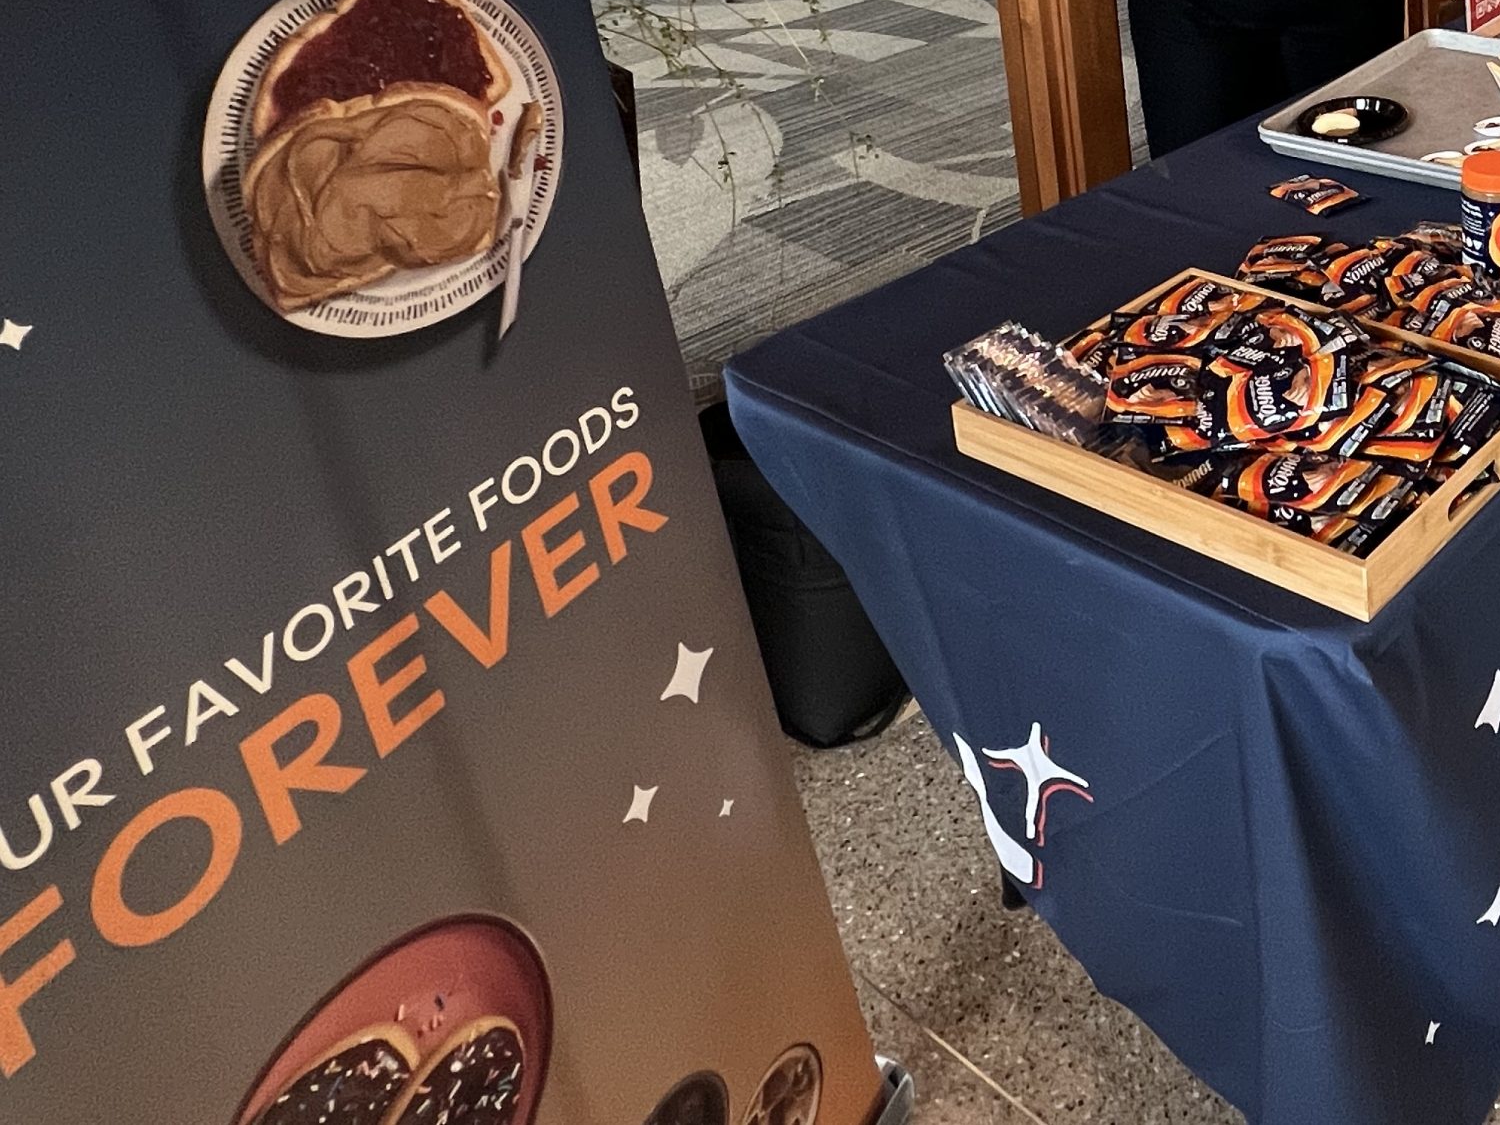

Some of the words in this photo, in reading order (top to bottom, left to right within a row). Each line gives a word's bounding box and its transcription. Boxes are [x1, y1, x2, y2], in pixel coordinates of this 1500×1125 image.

[0, 758, 116, 871] UR
[125, 508, 462, 775] FAVORITE
[468, 386, 640, 532] FOODS
[0, 451, 670, 1075] FOREVER
